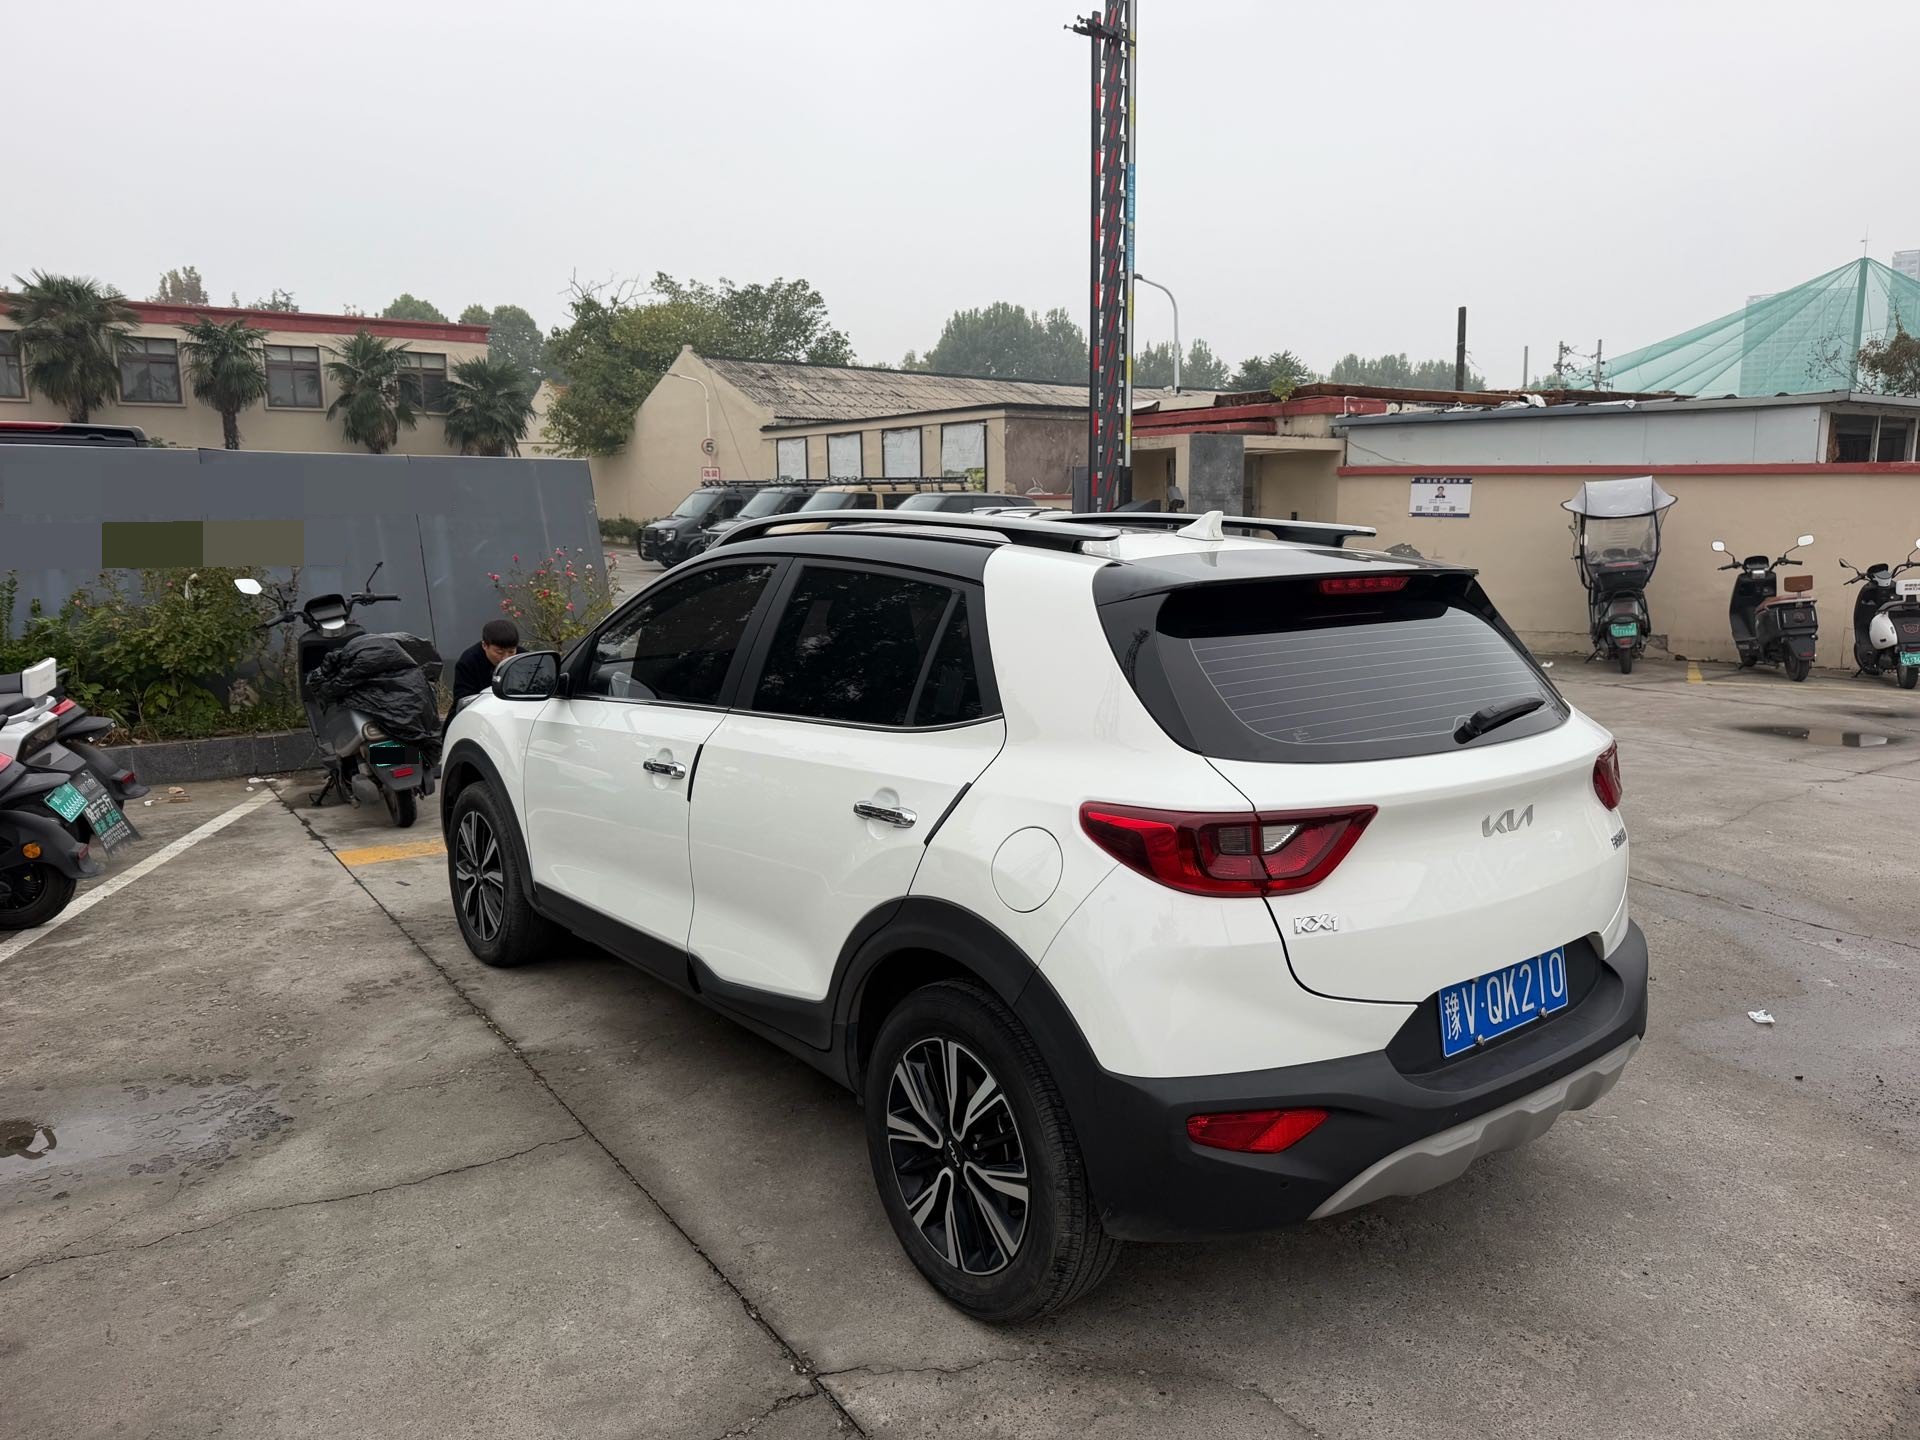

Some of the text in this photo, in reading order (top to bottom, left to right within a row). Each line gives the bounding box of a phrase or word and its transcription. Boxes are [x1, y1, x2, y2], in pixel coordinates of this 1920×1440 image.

[706, 442, 714, 452] 5
[1482, 804, 1533, 838] KIA
[1294, 914, 1340, 935] KX1
